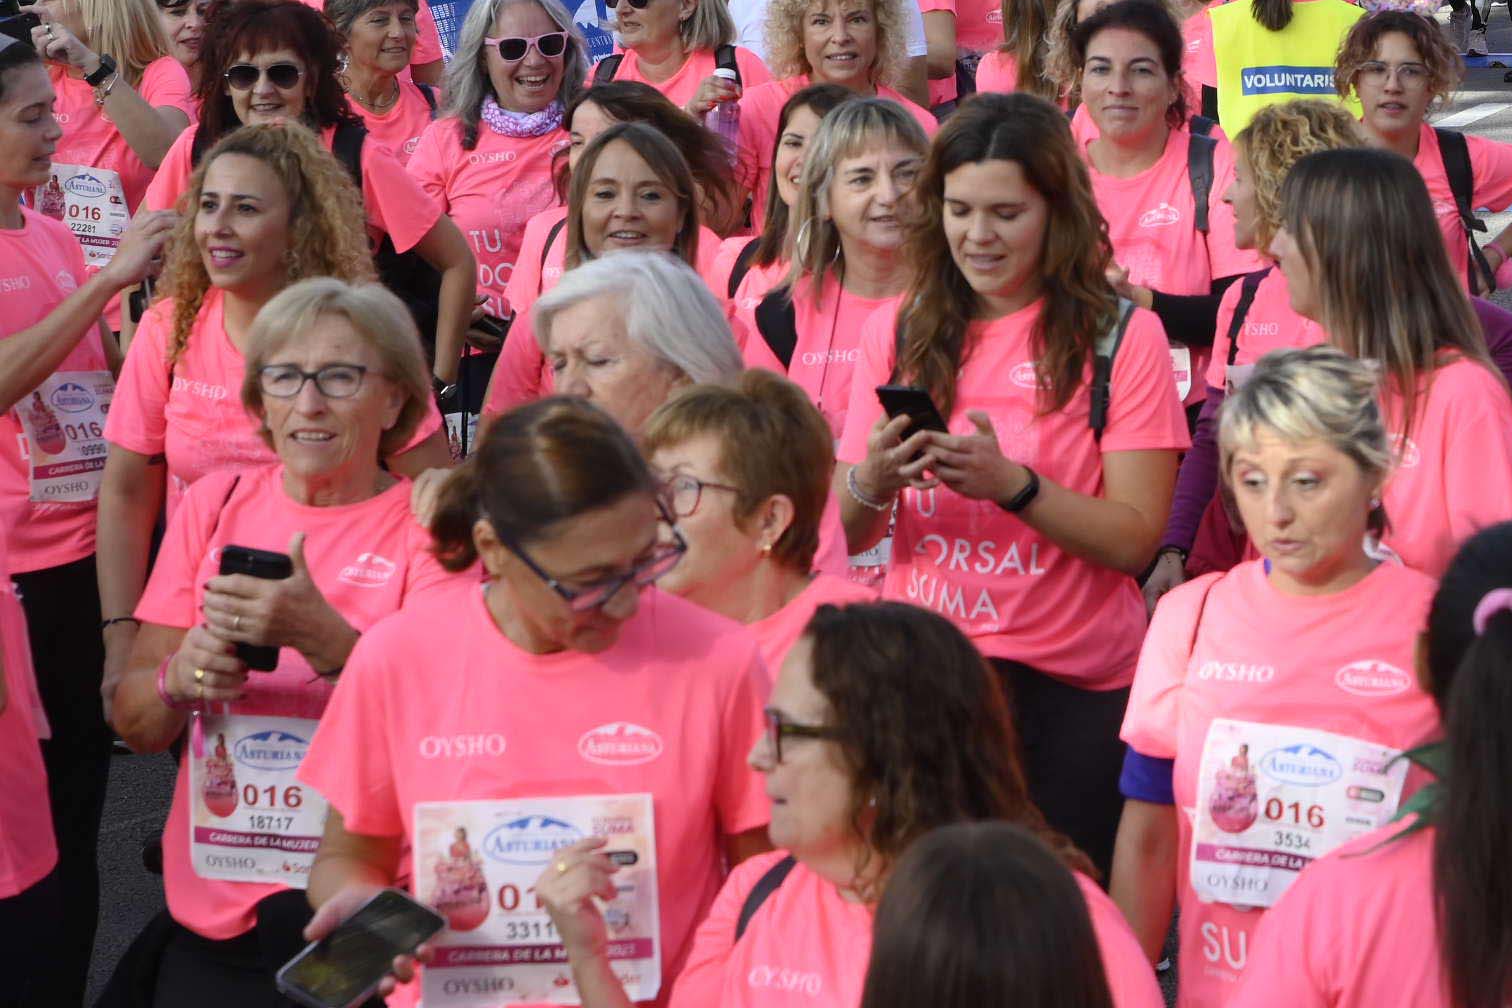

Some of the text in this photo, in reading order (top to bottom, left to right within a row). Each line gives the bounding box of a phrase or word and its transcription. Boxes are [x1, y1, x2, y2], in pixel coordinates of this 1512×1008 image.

[469, 151, 517, 165] OYSHO
[68, 204, 101, 221] 016
[70, 222, 96, 234] 22281
[469, 229, 503, 253] TU
[65, 421, 103, 441] 016
[44, 480, 89, 496] OYSHO
[906, 567, 1001, 621] SUMA
[1199, 660, 1275, 683] OYSHO
[419, 734, 507, 760] OYSHO
[1270, 757, 1335, 781] ASTURIANA
[243, 783, 304, 809] 016
[248, 814, 294, 832] 18717
[1264, 797, 1325, 829] 016
[208, 831, 252, 845] CARRERA
[253, 836, 269, 847] DE
[281, 838, 319, 850] MUJER
[205, 854, 257, 870] OYSHO
[1215, 847, 1269, 868] CARRERA
[1272, 853, 1288, 868] DE
[1207, 873, 1269, 894] OYSHO
[448, 949, 511, 964] CARRERA
[512, 947, 532, 961] DE
[533, 947, 551, 960] LA
[443, 976, 515, 994] OYSHO
[748, 964, 823, 995] OYSHO
